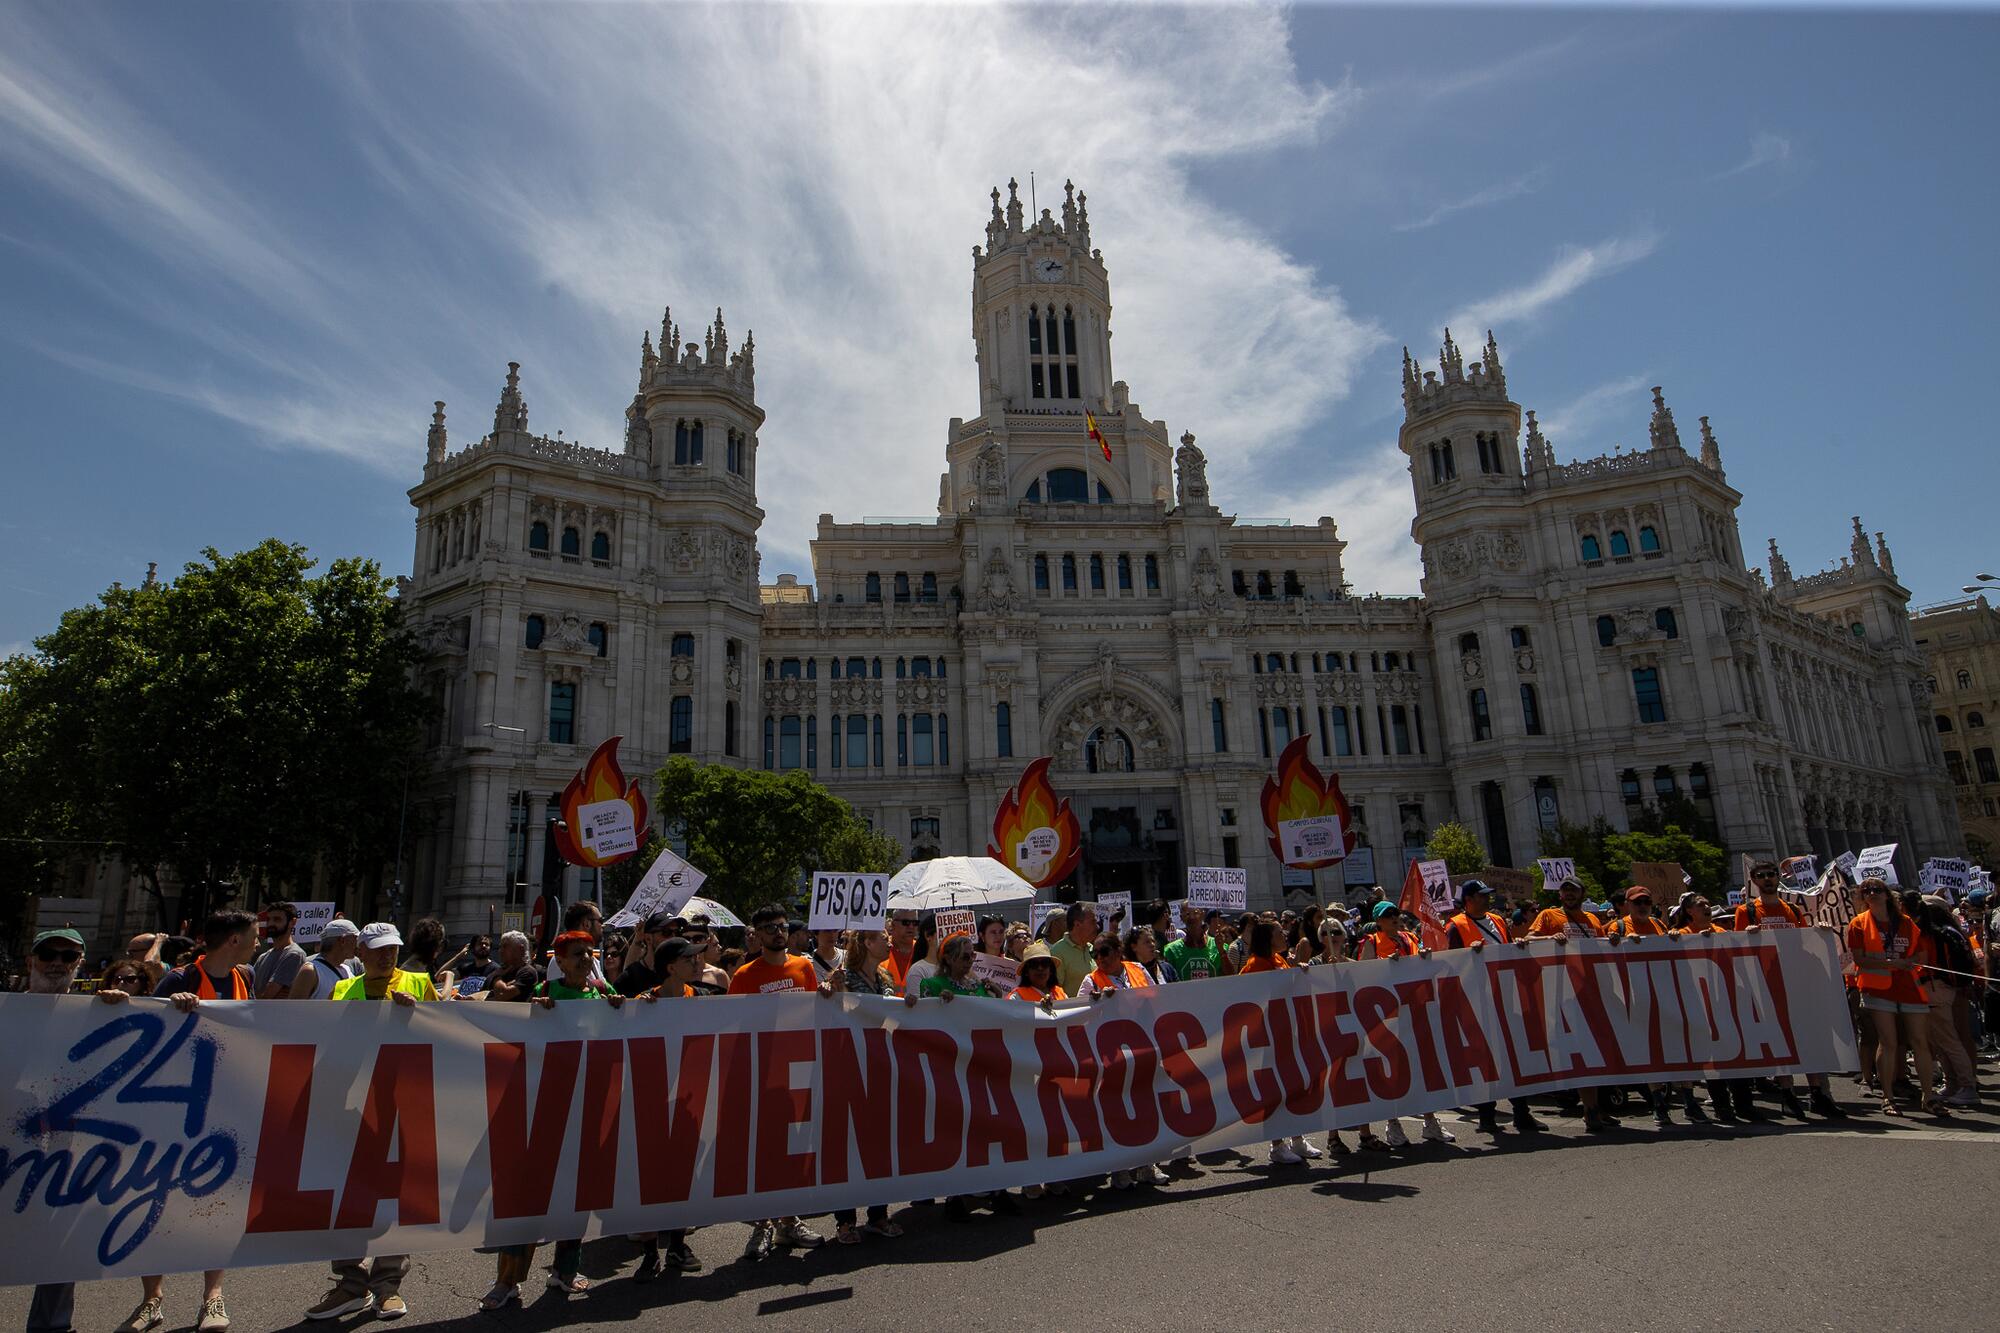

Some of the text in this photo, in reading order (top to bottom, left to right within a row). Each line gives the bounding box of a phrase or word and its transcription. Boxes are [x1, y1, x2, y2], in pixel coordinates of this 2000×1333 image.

[1933, 859, 1966, 873] DERECHO
[1219, 872, 1224, 884] A
[1189, 888, 1195, 901] A
[1195, 888, 1220, 902] PRECIO
[304, 908, 330, 919] calle?
[937, 911, 974, 927] DERECHO
[938, 928, 944, 939] A
[1189, 961, 1208, 969] PAH
[759, 978, 794, 993] SINDICATO
[1497, 964, 1606, 1077] LA
[20, 1012, 218, 1144] 24
[246, 976, 1499, 1233] LA VIVIENDA NOS CUESTA
[0, 1130, 238, 1266] mayo
